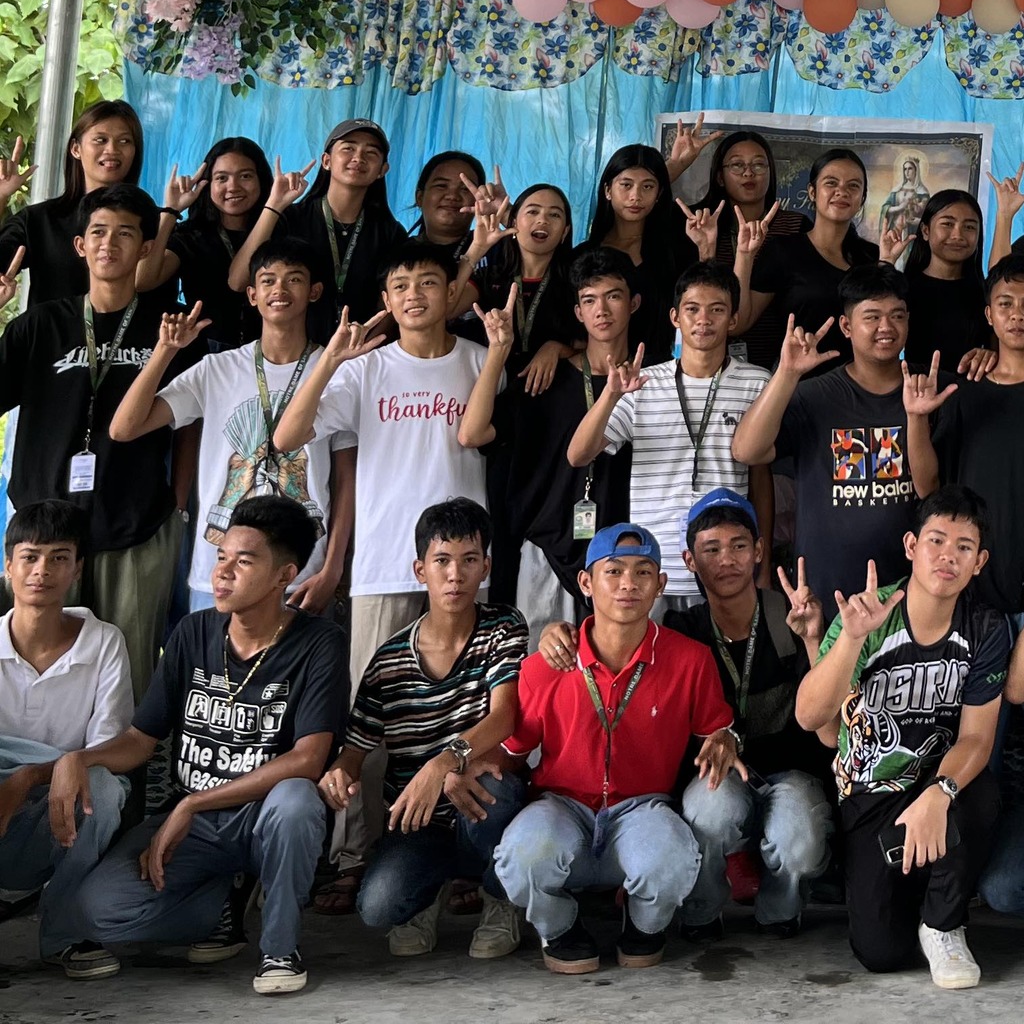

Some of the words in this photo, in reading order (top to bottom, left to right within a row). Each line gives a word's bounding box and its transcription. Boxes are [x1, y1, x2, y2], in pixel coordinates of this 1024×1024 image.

[378, 393, 467, 426] thankfu
[832, 484, 869, 499] new
[624, 681, 636, 701] NOTRE
[634, 662, 644, 680] DAME
[181, 734, 213, 767] The
